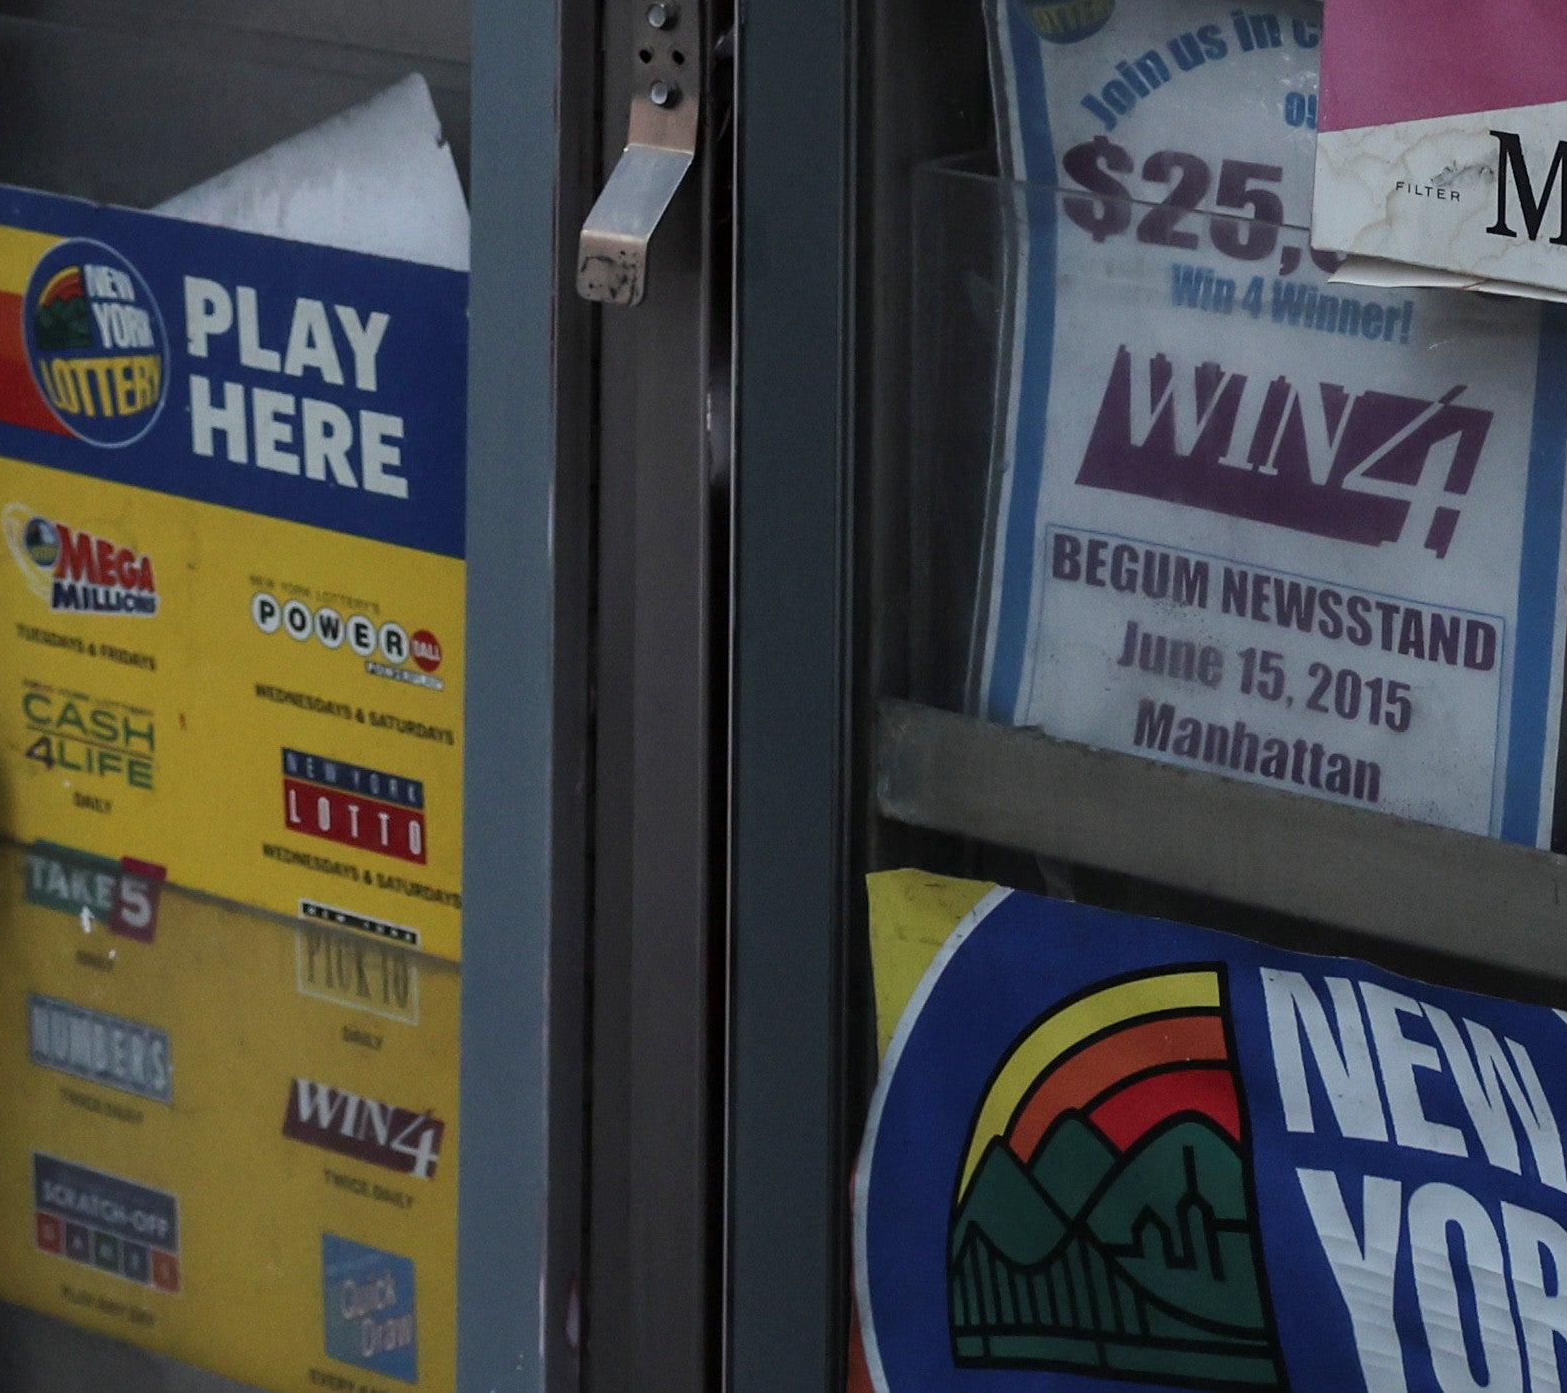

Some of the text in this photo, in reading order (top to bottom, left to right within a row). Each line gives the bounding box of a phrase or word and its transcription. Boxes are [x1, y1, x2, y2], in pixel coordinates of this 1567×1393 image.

[1080, 49, 1171, 131] Join
[1167, 20, 1229, 73] us
[1230, 10, 1283, 53] in
[1395, 181, 1463, 203] FILTER
[83, 264, 136, 303] NEW
[1172, 263, 1416, 345] Win 4 Winner!
[91, 301, 156, 350] YORK
[184, 275, 391, 393] PLAY
[39, 353, 164, 418] LOTTERY
[189, 374, 410, 501] HERE
[55, 521, 157, 595] MEGA
[1051, 531, 1498, 673] BEGUM NEWSSTAND
[1117, 620, 1413, 734] June 15, 2015
[22, 691, 156, 753] CASH
[1132, 697, 1383, 804] Manhattan
[25, 735, 156, 792] 4LIFE
[288, 788, 422, 856] LOTTO
